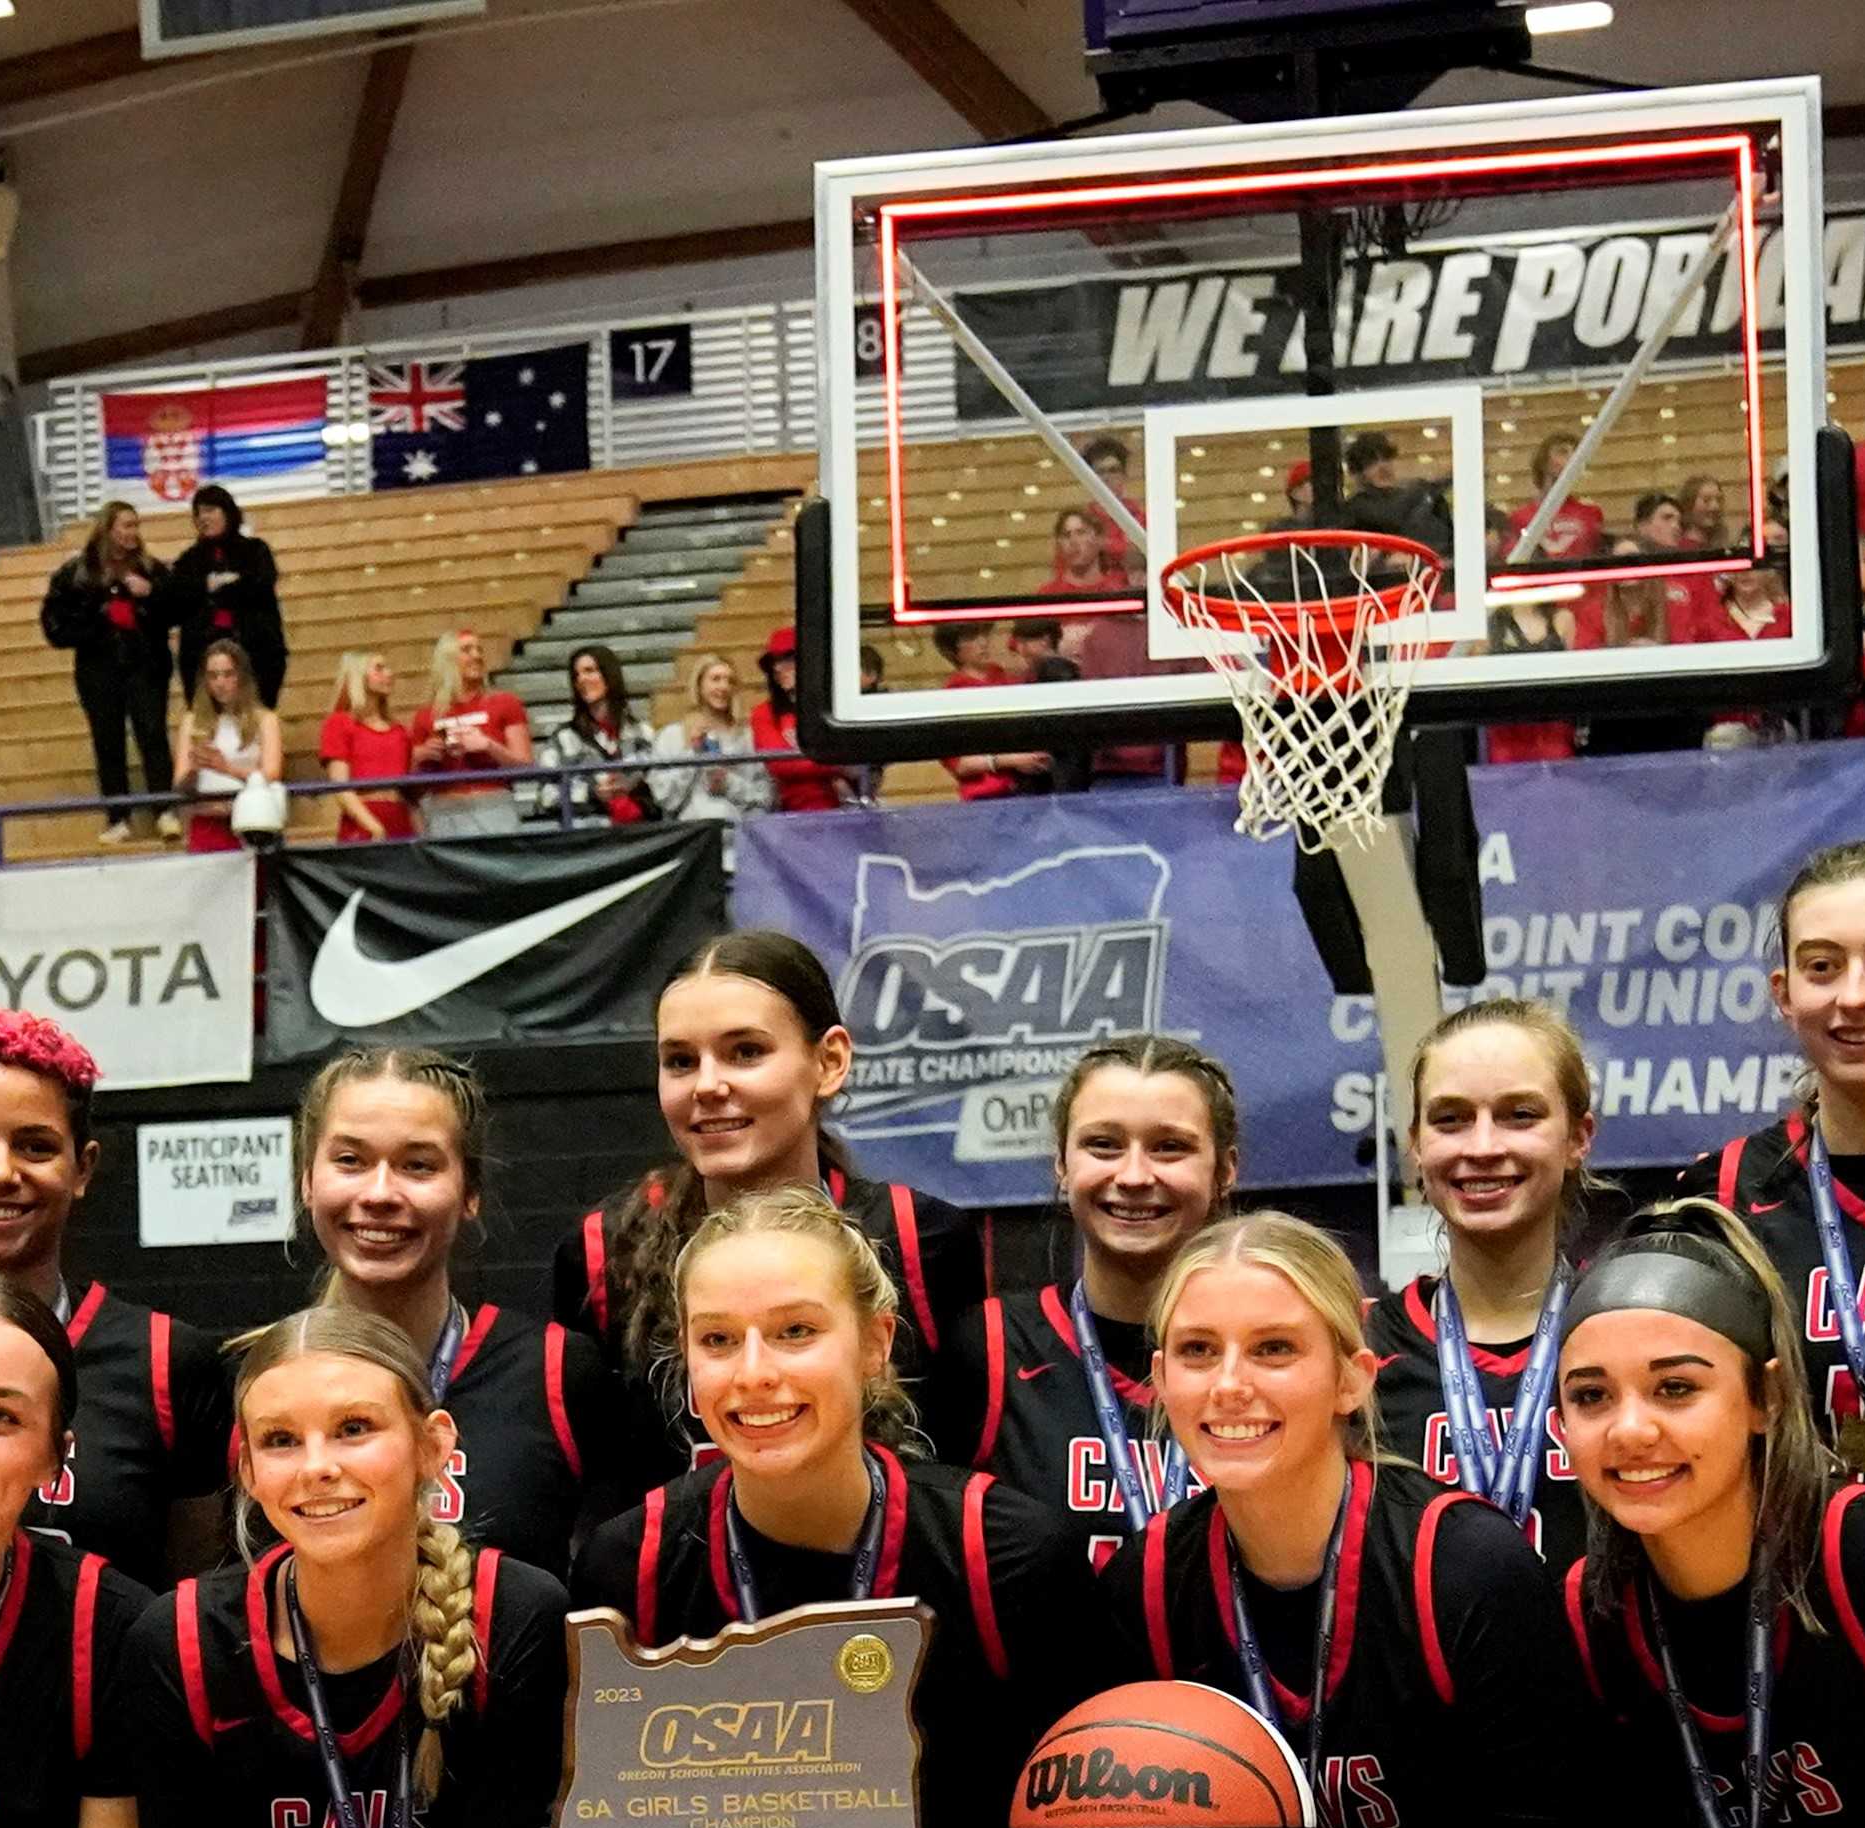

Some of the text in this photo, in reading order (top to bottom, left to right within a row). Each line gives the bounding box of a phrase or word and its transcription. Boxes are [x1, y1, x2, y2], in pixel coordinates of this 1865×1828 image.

[1107, 274, 1276, 387] WE
[629, 340, 677, 383] 17
[841, 922, 1169, 1052] OSAA
[148, 1133, 283, 1162] PARTICIPANT
[171, 1162, 260, 1189] SEATING
[594, 1688, 643, 1704] 2023
[640, 1698, 836, 1769] OSAA
[1026, 1746, 1214, 1811] Wilson
[576, 1788, 909, 1820] 6A GIRLS BASKETBALL
